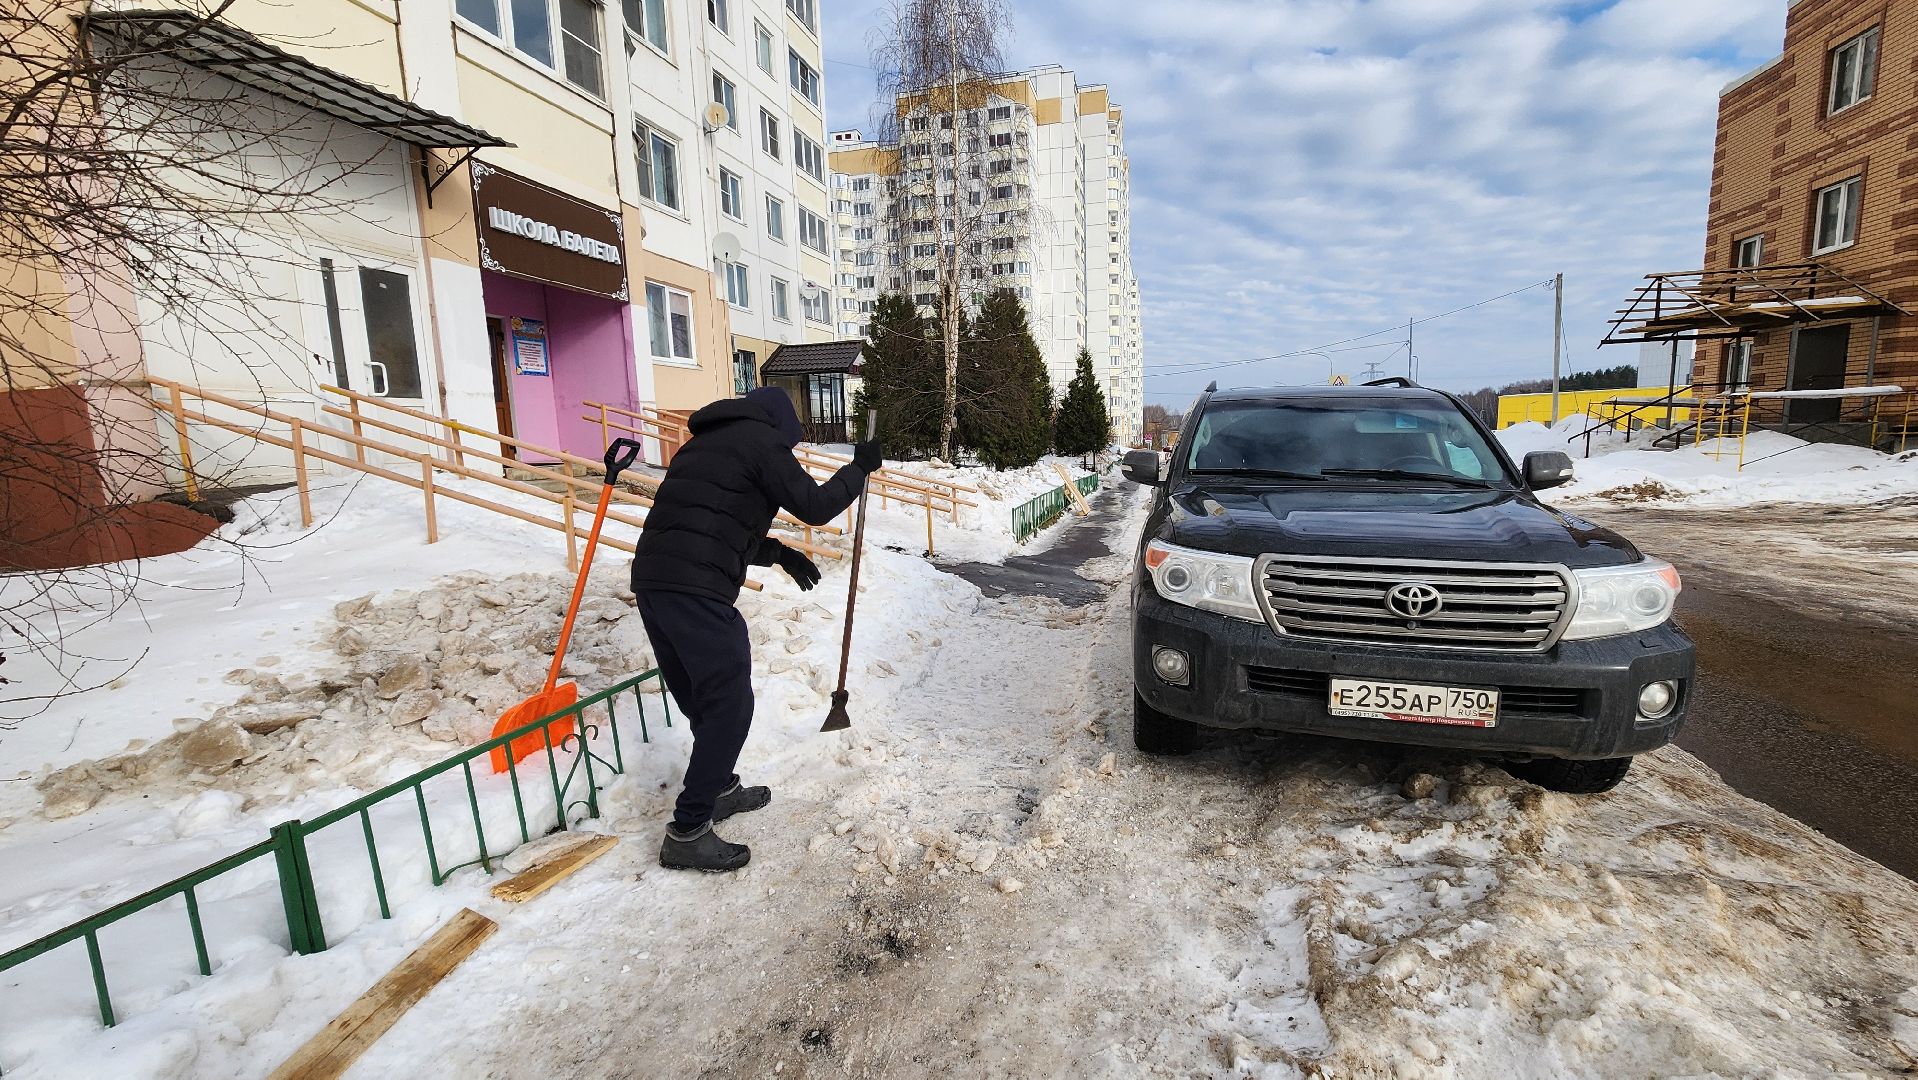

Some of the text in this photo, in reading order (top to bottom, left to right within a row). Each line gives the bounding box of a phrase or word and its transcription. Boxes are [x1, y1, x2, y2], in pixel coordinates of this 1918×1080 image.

[488, 206, 622, 265] ШКОЛА БАЛЕТА
[1449, 690, 1490, 710] 750
[1458, 708, 1478, 717] RUS
